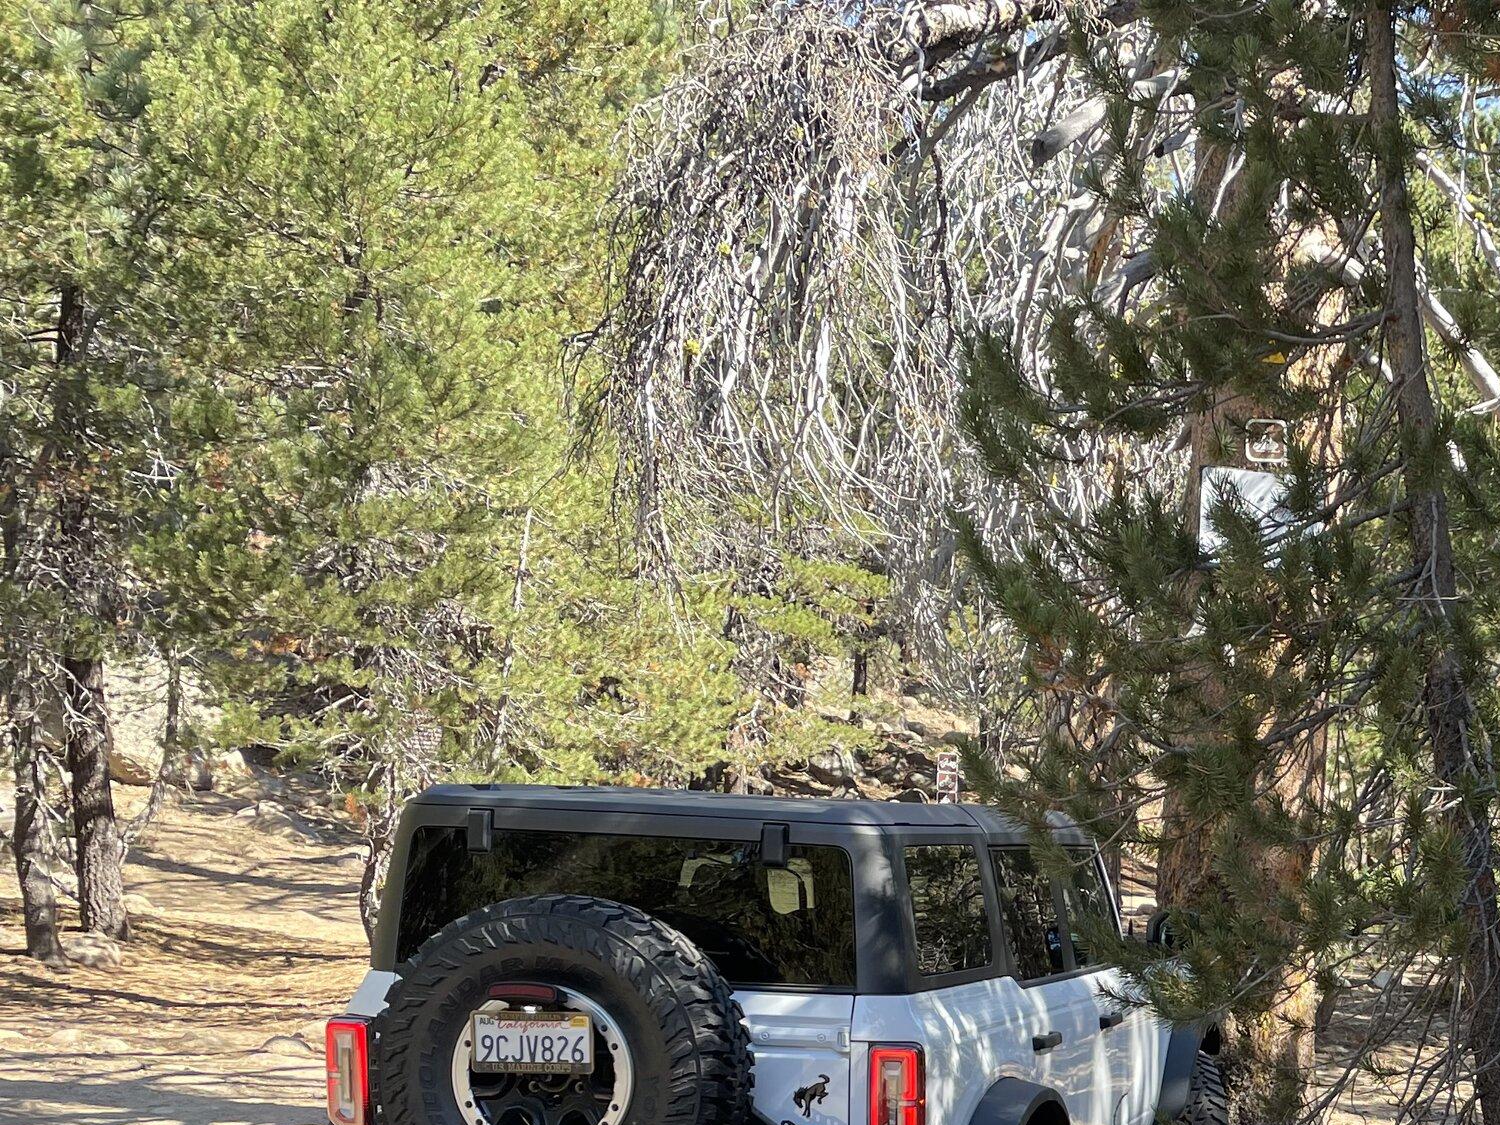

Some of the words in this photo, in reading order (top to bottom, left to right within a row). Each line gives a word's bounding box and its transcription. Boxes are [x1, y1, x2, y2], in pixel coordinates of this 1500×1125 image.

[479, 1017, 495, 1026] AUG
[497, 1019, 569, 1033] California
[481, 1034, 584, 1063] 9CJV826
[508, 1064, 542, 1072] MARINE
[545, 1064, 571, 1072] CORPS
